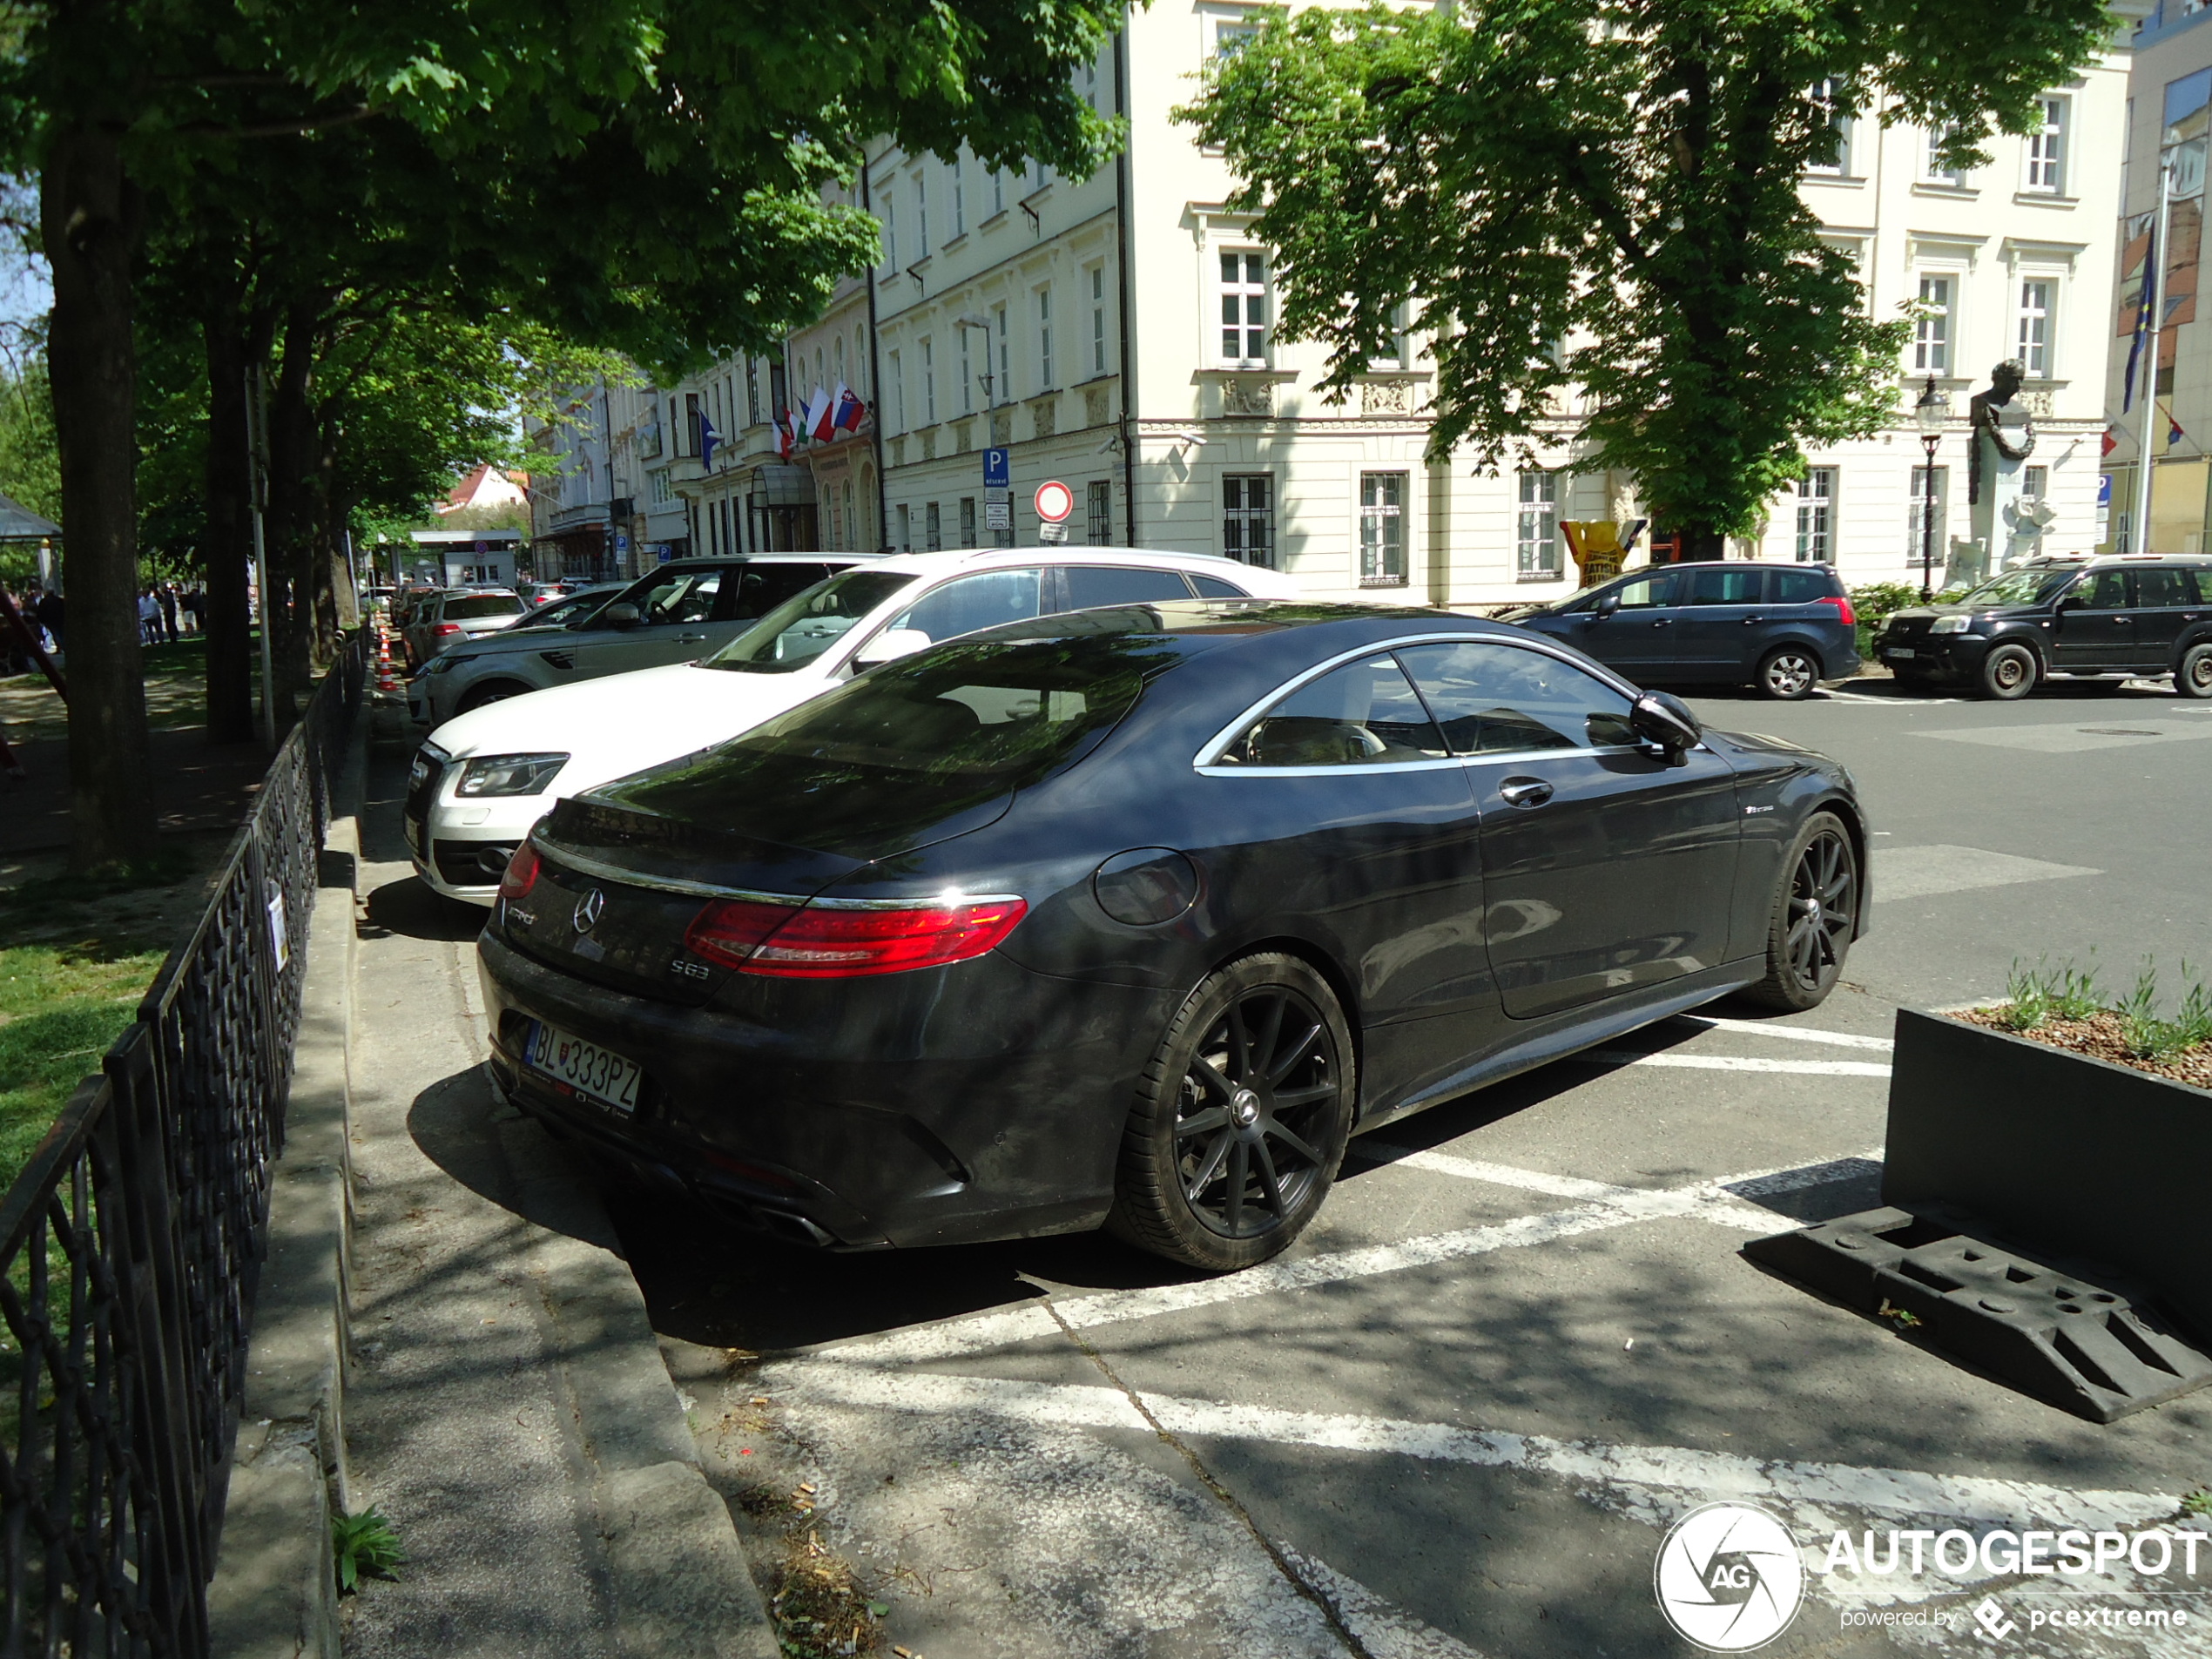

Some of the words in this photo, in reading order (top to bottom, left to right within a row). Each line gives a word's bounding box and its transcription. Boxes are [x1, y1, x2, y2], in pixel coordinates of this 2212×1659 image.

[989, 451, 1001, 472] P
[618, 537, 624, 546] P
[661, 547, 668, 556] P
